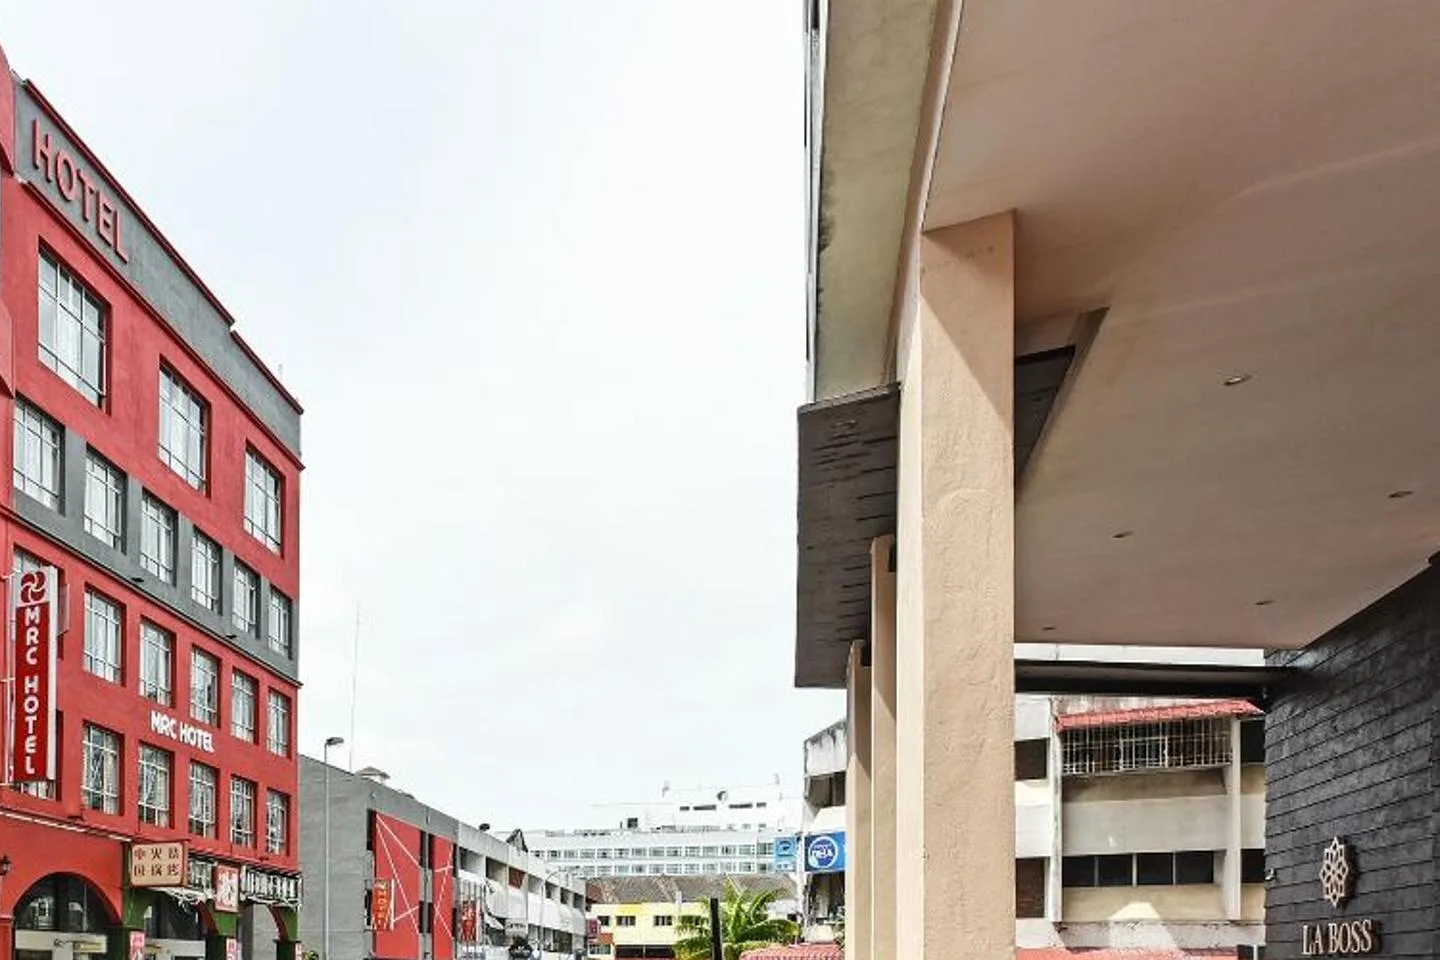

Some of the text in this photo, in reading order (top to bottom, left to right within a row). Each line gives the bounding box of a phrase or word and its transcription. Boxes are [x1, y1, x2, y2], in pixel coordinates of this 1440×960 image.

[32, 118, 129, 264] HOTEL
[23, 606, 40, 775] MRC HOTEL
[151, 709, 215, 753] MRC HOTEL
[1302, 919, 1372, 955] LA BOSS
